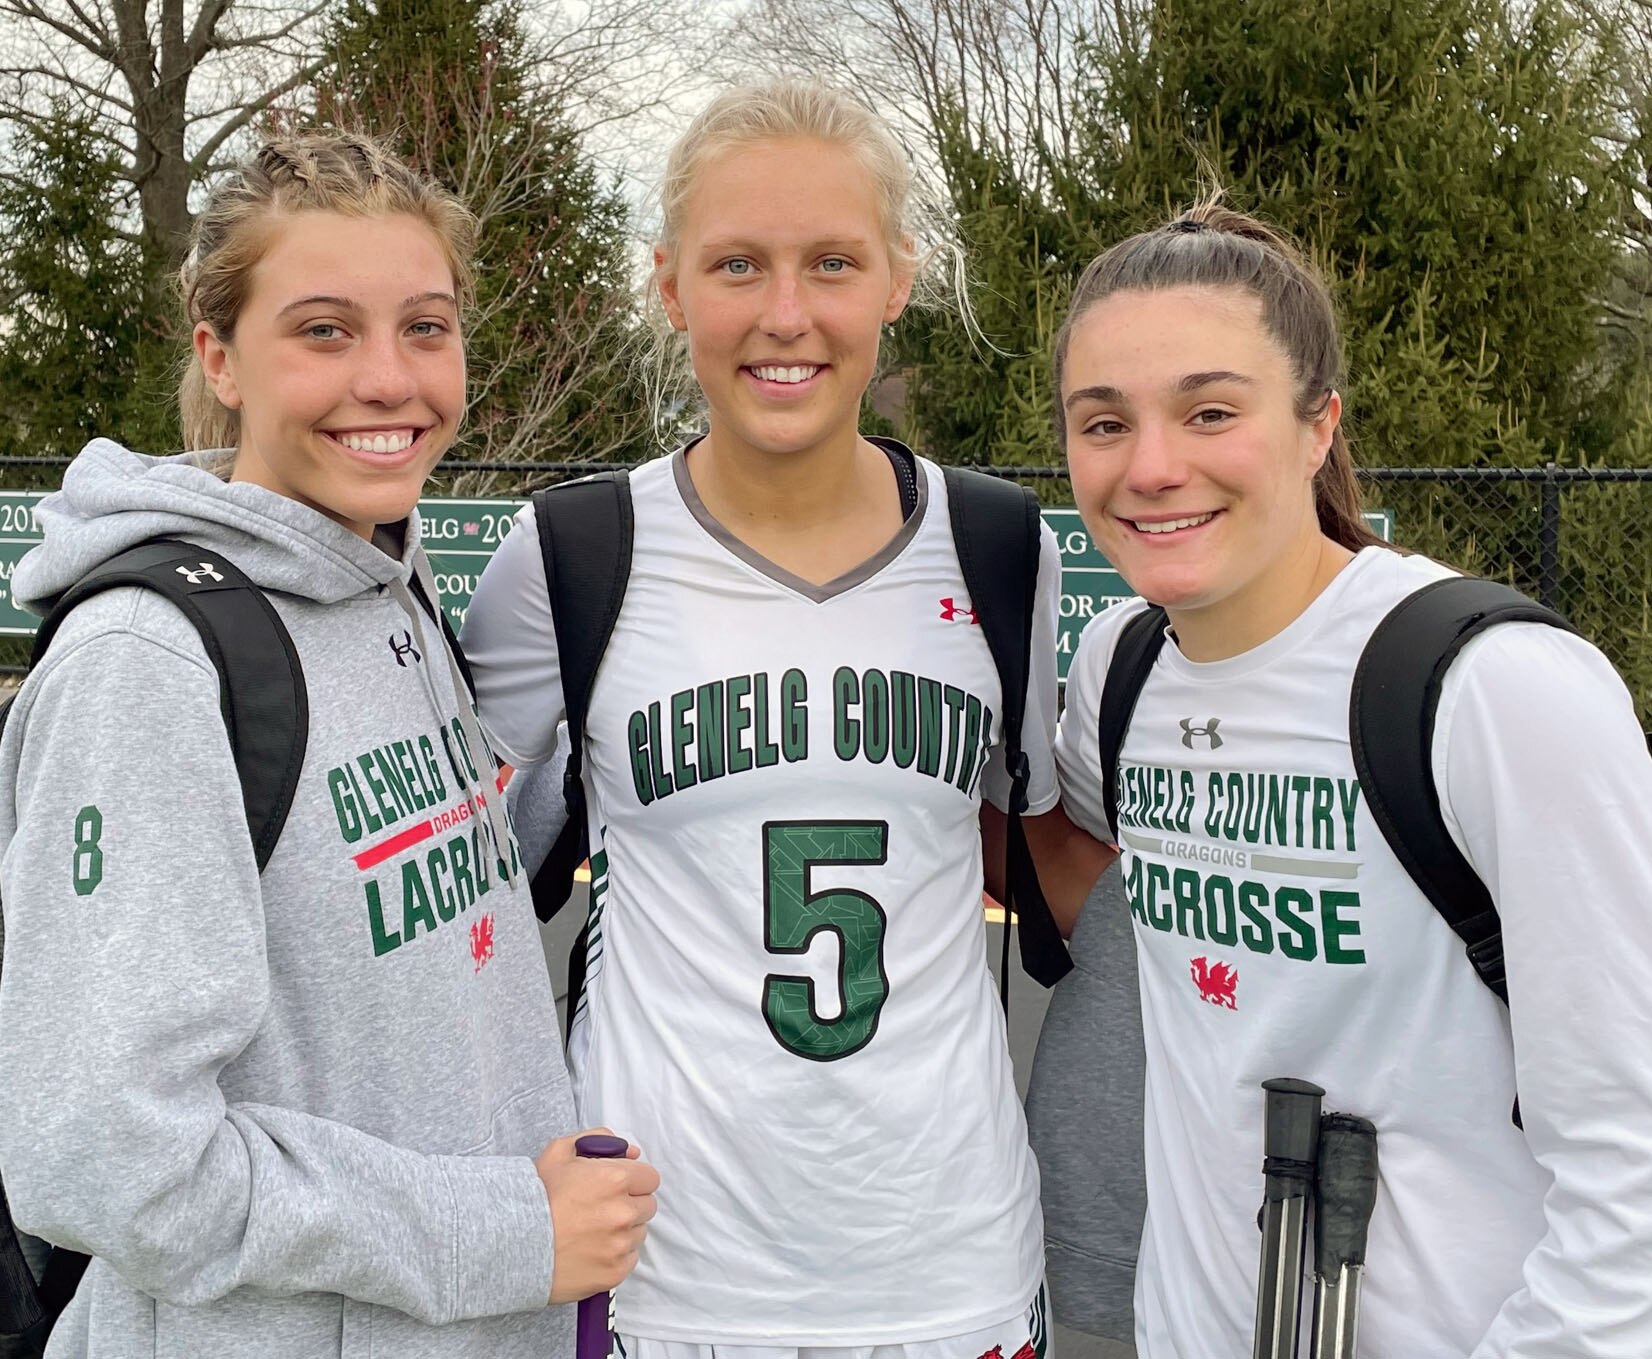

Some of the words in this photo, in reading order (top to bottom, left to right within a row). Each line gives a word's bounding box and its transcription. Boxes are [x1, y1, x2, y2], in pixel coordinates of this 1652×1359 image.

[0, 505, 46, 533] 201
[419, 518, 460, 539] ELG
[481, 514, 514, 543] 20
[434, 573, 480, 596] COU
[628, 668, 808, 806] GLENELG
[327, 734, 447, 844] GLENELG
[432, 792, 487, 835] DRAGON
[1117, 766, 1196, 834] LENELG
[1204, 771, 1361, 852] COUNTRY
[72, 804, 103, 897] 8
[364, 802, 525, 958] LACRO
[1165, 840, 1247, 870] DRAGONS
[761, 819, 890, 1063] 5
[1122, 852, 1367, 965] ACROSSE
